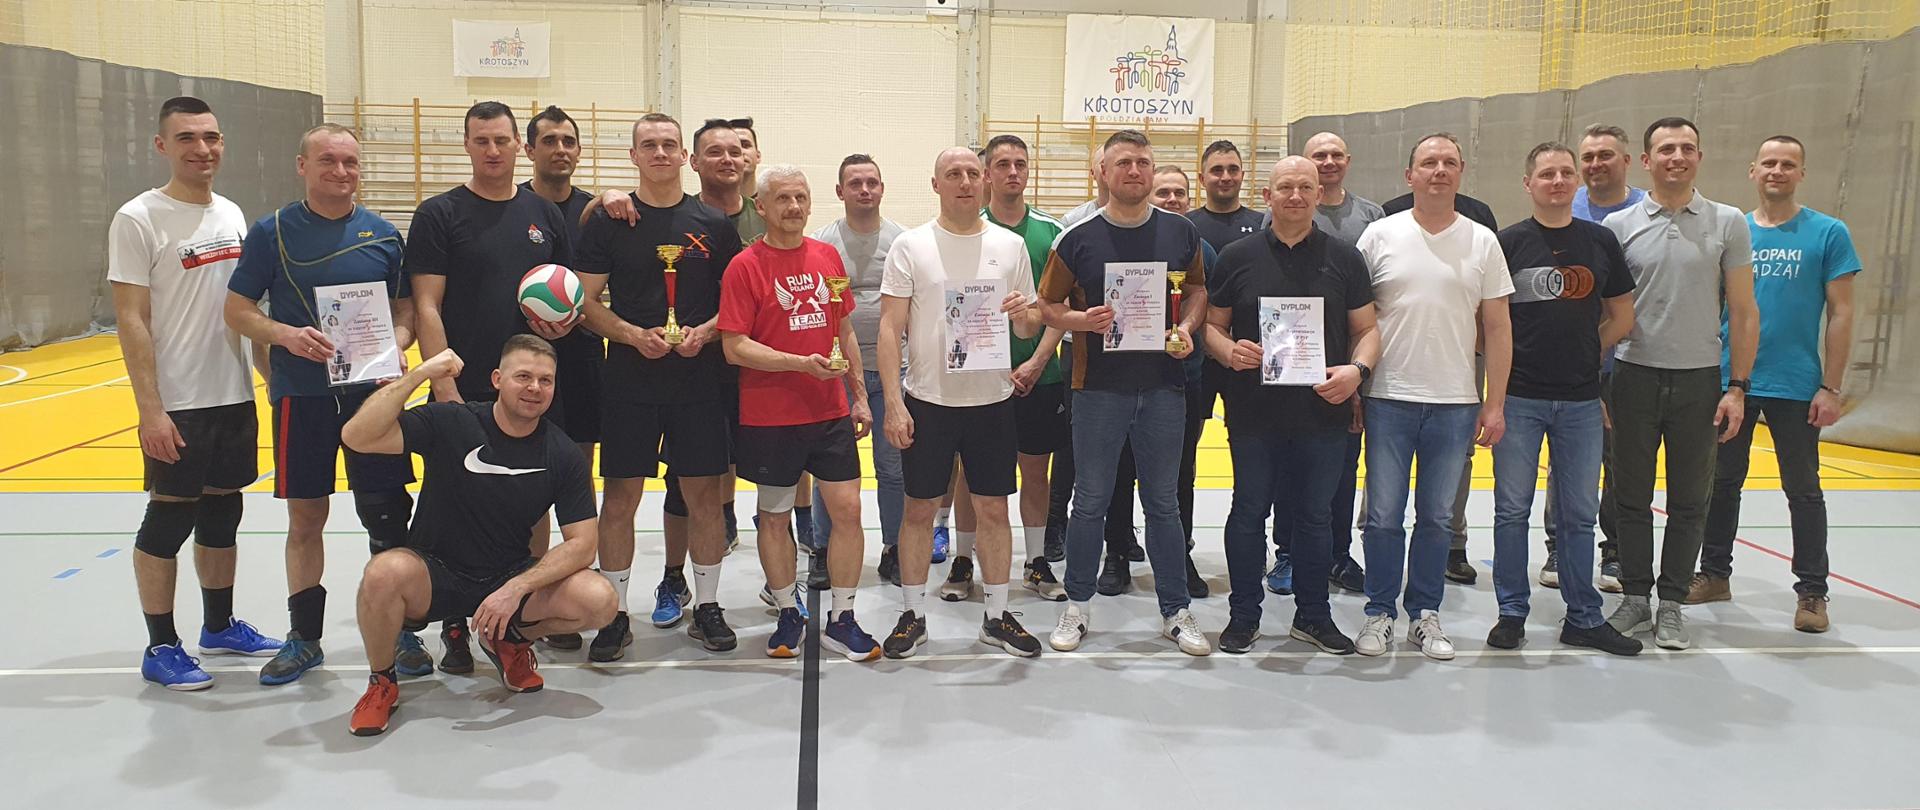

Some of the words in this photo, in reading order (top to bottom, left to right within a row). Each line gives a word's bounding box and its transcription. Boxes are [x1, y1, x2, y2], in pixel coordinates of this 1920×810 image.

[479, 58, 529, 66] KROTOSZYN
[1084, 96, 1193, 115] KROTOSZYN
[1752, 248, 1802, 261] ŁOPAKI
[1752, 263, 1800, 280] ĄDZĄ!
[786, 273, 814, 287] RUN
[789, 284, 815, 292] POLAND
[965, 285, 995, 293] DYPLOM
[340, 289, 374, 299] DYPLOM
[1281, 303, 1311, 311] DYPLOM
[790, 313, 825, 325] TEAM
